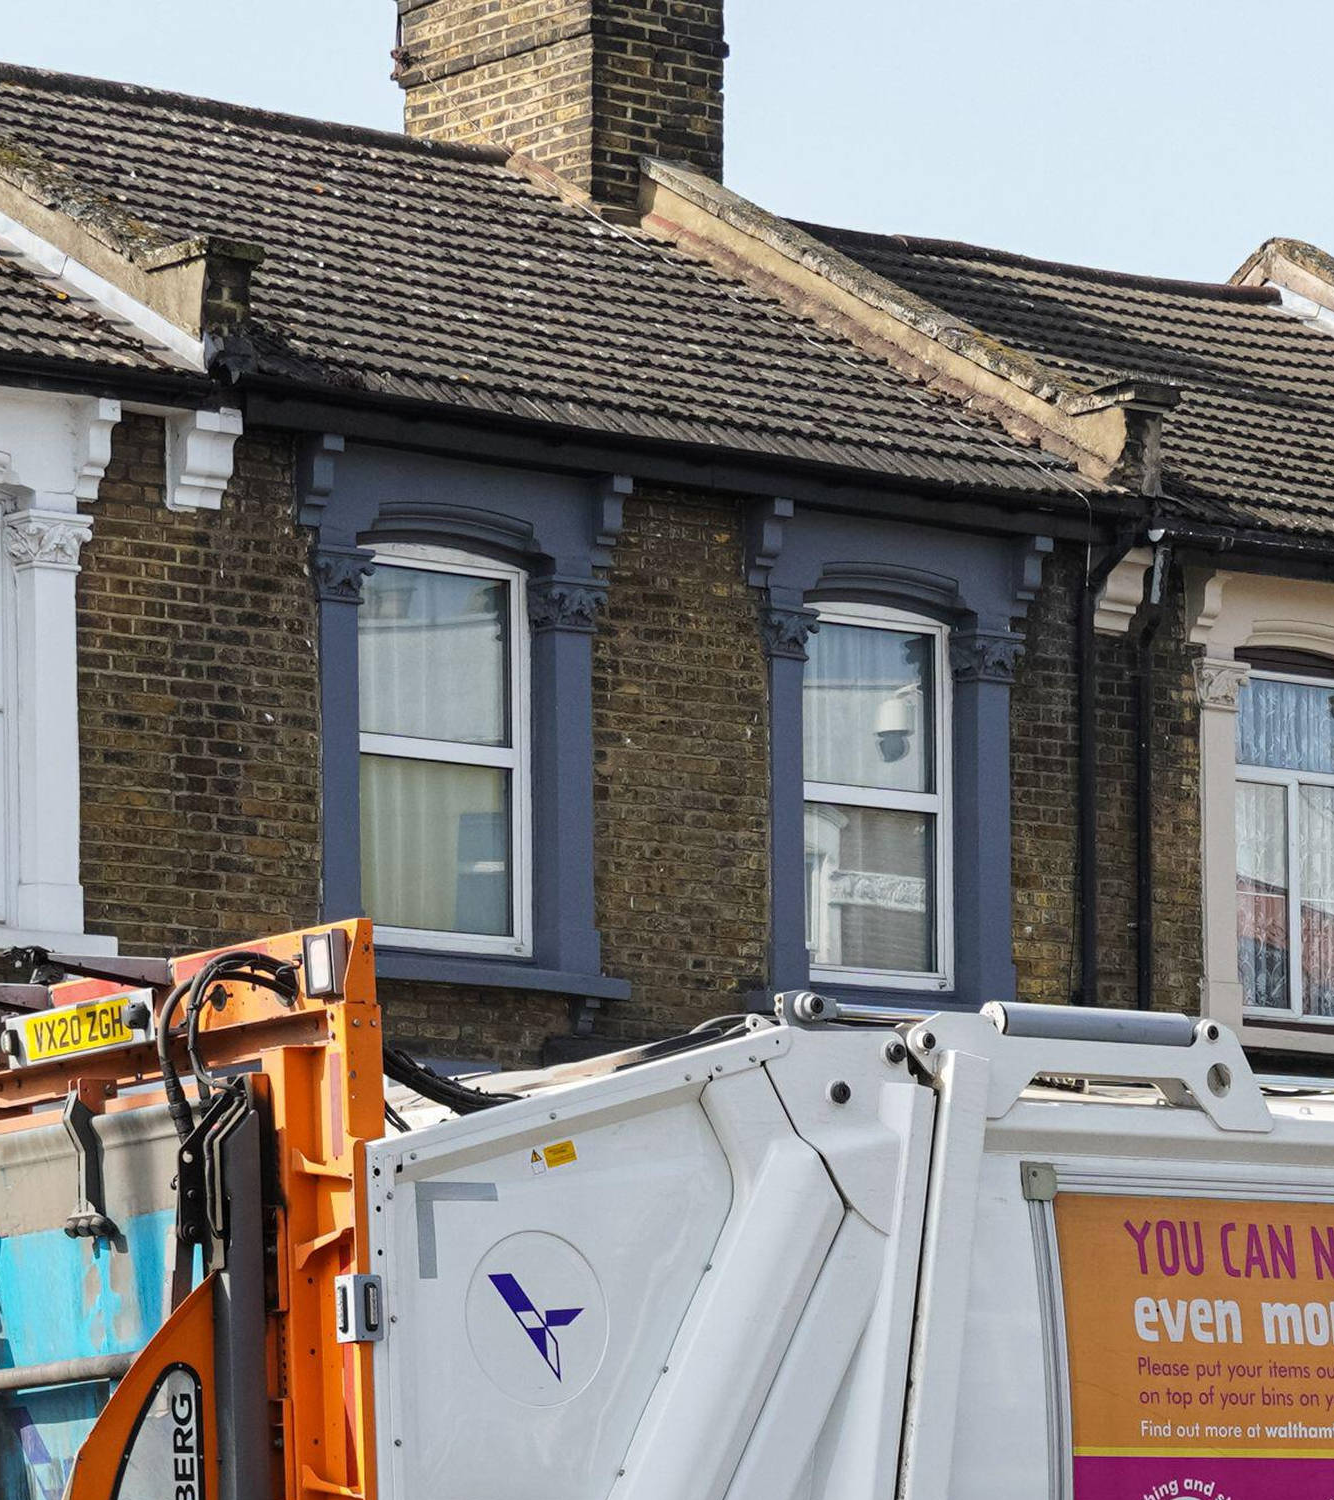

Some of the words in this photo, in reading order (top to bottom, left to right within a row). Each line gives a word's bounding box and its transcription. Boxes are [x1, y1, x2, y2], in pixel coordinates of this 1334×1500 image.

[33, 1015, 82, 1053] VX20
[86, 1005, 124, 1042] ZGH
[1123, 1219, 1205, 1277] YOU
[1220, 1222, 1297, 1280] CAN
[1134, 1296, 1243, 1344] even
[1137, 1356, 1190, 1377] Please
[1196, 1360, 1222, 1381] put
[1227, 1364, 1263, 1382] your
[1269, 1359, 1311, 1379] items
[1139, 1391, 1160, 1405] on
[1166, 1388, 1193, 1409] top
[1199, 1385, 1215, 1405] of
[1220, 1391, 1256, 1410] your
[1261, 1386, 1294, 1406] bins
[1300, 1393, 1320, 1407] on
[1140, 1420, 1171, 1437] Find
[1176, 1423, 1201, 1437] out
[1205, 1425, 1243, 1438] more
[1247, 1424, 1261, 1438] at
[1183, 1478, 1216, 1497] and
